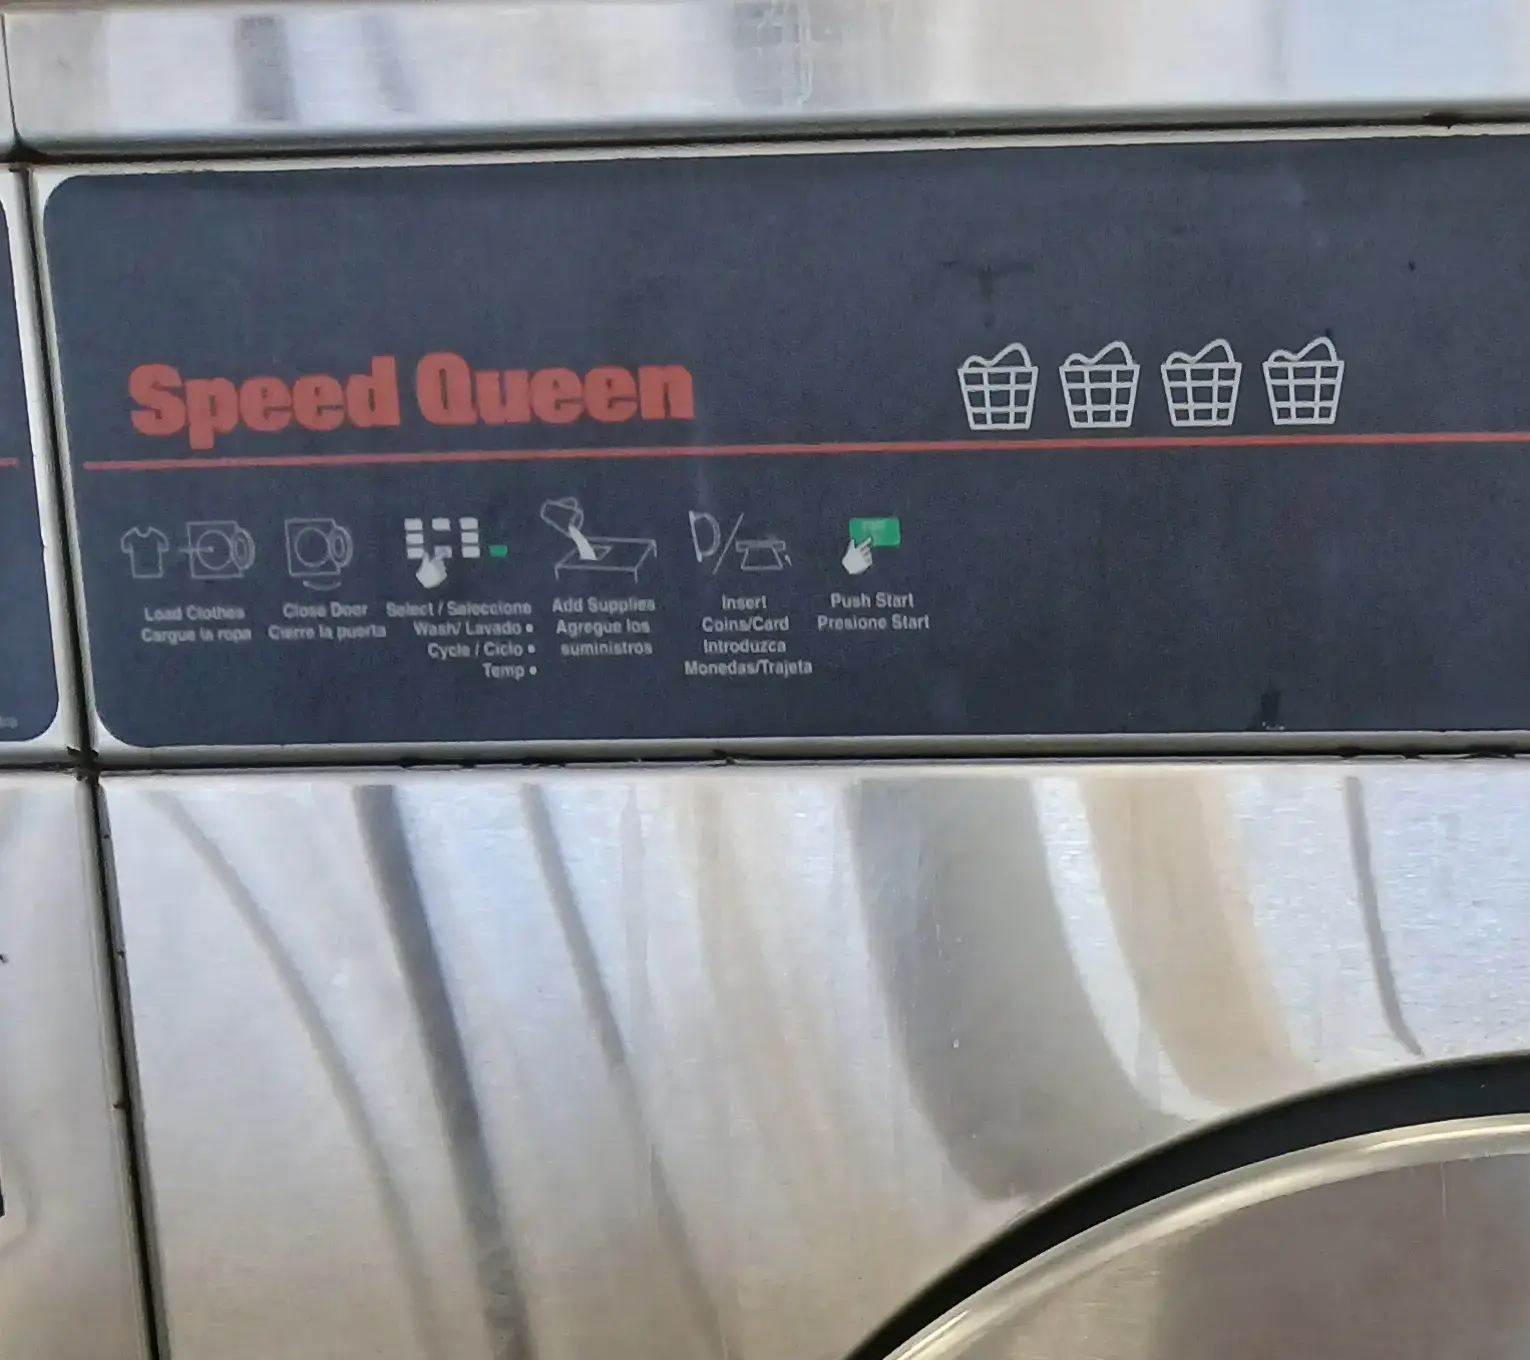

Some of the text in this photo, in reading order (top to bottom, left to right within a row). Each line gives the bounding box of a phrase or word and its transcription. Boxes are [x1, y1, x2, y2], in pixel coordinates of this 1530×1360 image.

[127, 351, 694, 450] Speed Queen
[551, 597, 656, 615] Add Supplies
[721, 594, 767, 610] Insert
[830, 592, 915, 608] Push Start
[143, 603, 246, 622] Load Clothes
[282, 601, 368, 619] Close Door
[385, 601, 435, 618] Select
[466, 620, 522, 636] Lavado
[555, 618, 650, 639] Agregue los
[701, 616, 789, 632] Coins/Card
[816, 613, 930, 631] Presione Start
[140, 627, 252, 646] Cargue la ropa
[267, 624, 387, 643] Cierre la puerta
[427, 642, 470, 660] Cycle
[483, 641, 523, 657] Ciclo
[560, 641, 653, 656] suministros
[703, 638, 786, 654] Introduzca
[482, 662, 525, 680] Temp
[684, 660, 813, 679] Monedas/Trajeta
